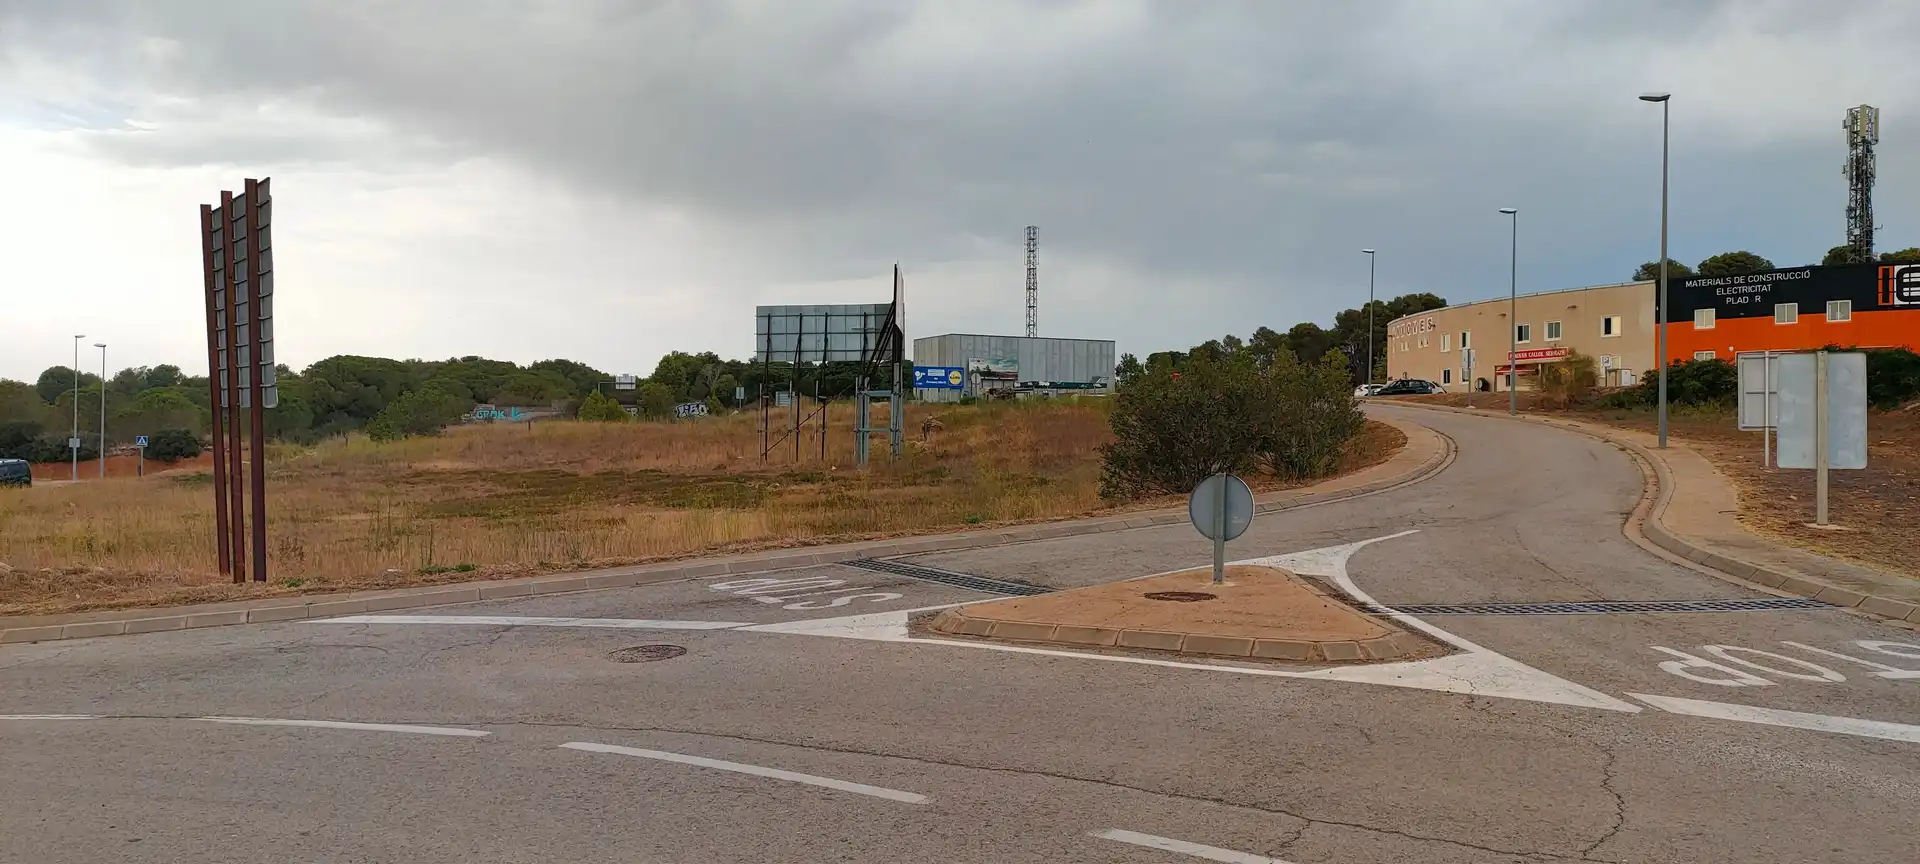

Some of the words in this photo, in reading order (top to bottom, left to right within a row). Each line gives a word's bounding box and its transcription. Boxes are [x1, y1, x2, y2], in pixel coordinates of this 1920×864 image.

[1685, 277, 1732, 288] MATERIALS
[1733, 275, 1746, 284] DE
[1747, 269, 1811, 283] CONSTRUCCIÓ
[1716, 284, 1773, 296] ELECTRICITAT
[709, 576, 903, 610] STOP
